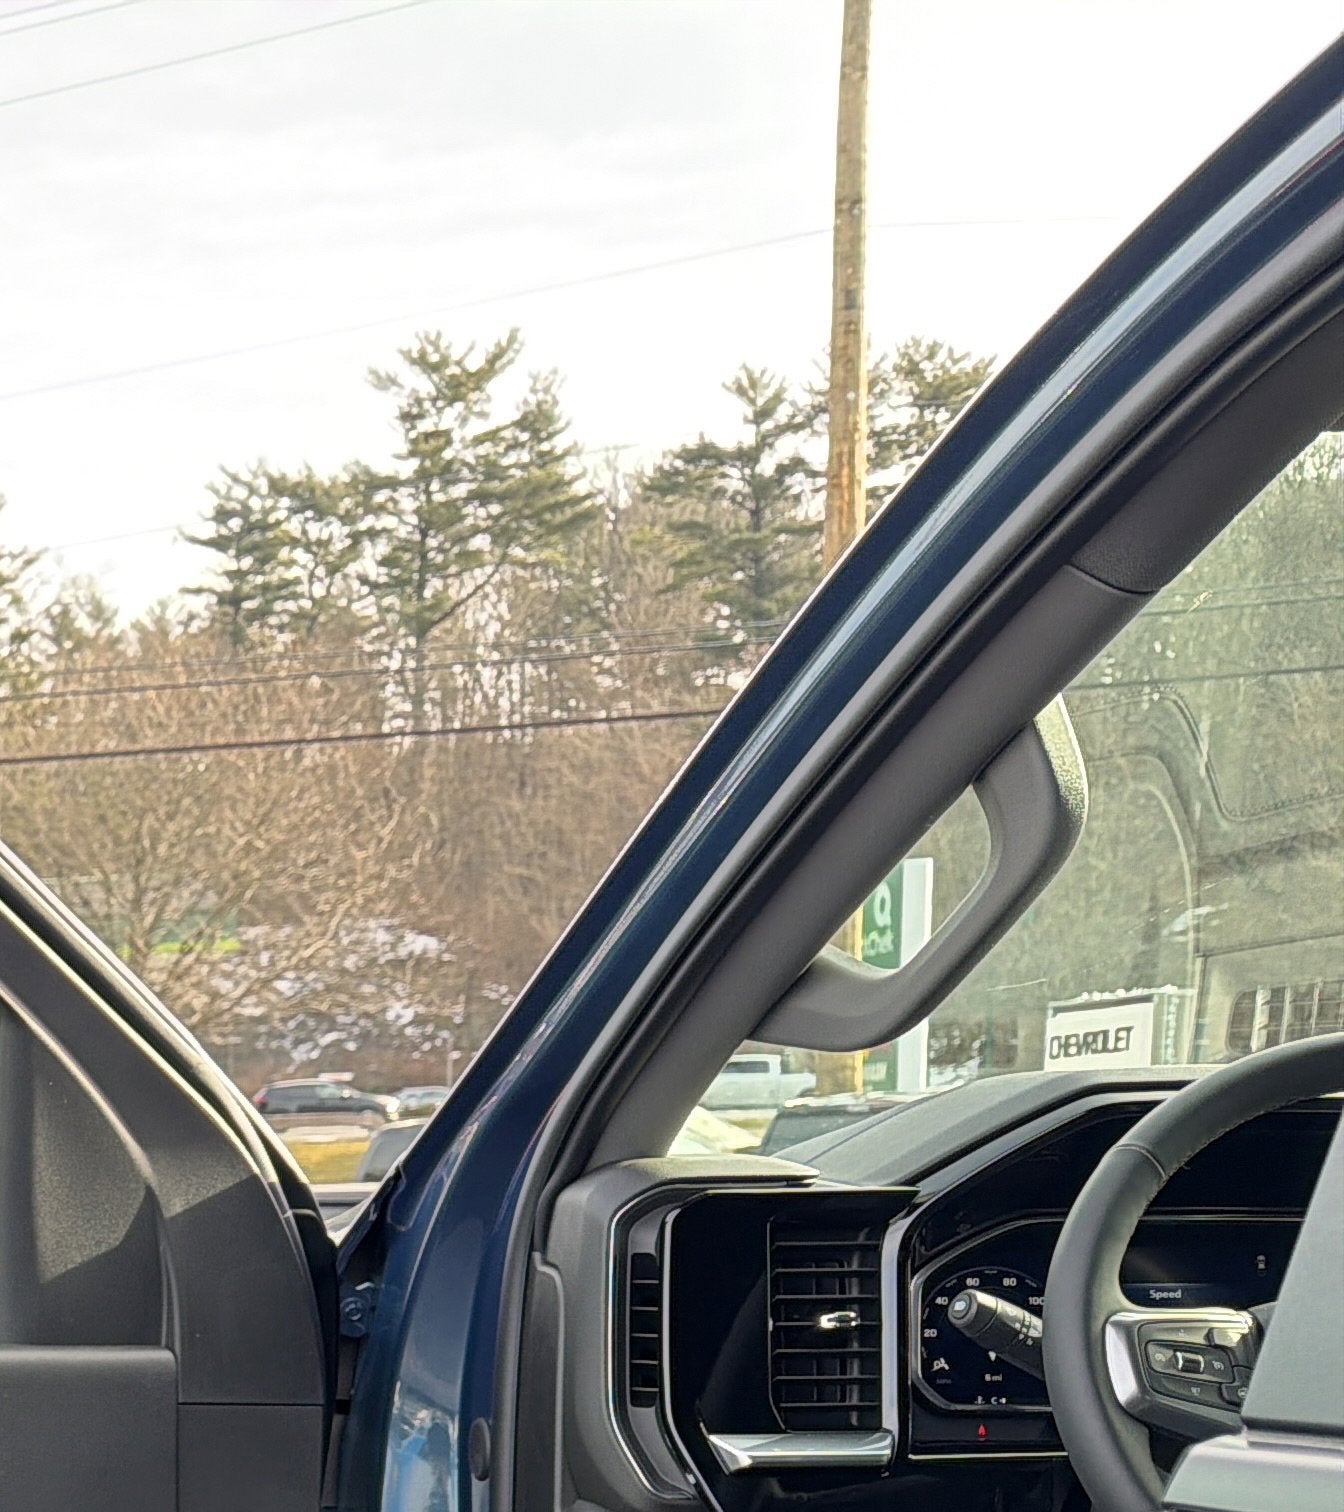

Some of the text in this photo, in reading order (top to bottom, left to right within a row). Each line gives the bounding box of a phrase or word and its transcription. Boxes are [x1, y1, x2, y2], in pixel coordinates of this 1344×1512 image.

[1049, 1025, 1134, 1060] CHEVROLET
[965, 1277, 980, 1287] 60
[1002, 1277, 1017, 1287] 80
[1149, 1289, 1182, 1300] Speed
[935, 1296, 949, 1305] 40
[924, 1328, 938, 1338] 20
